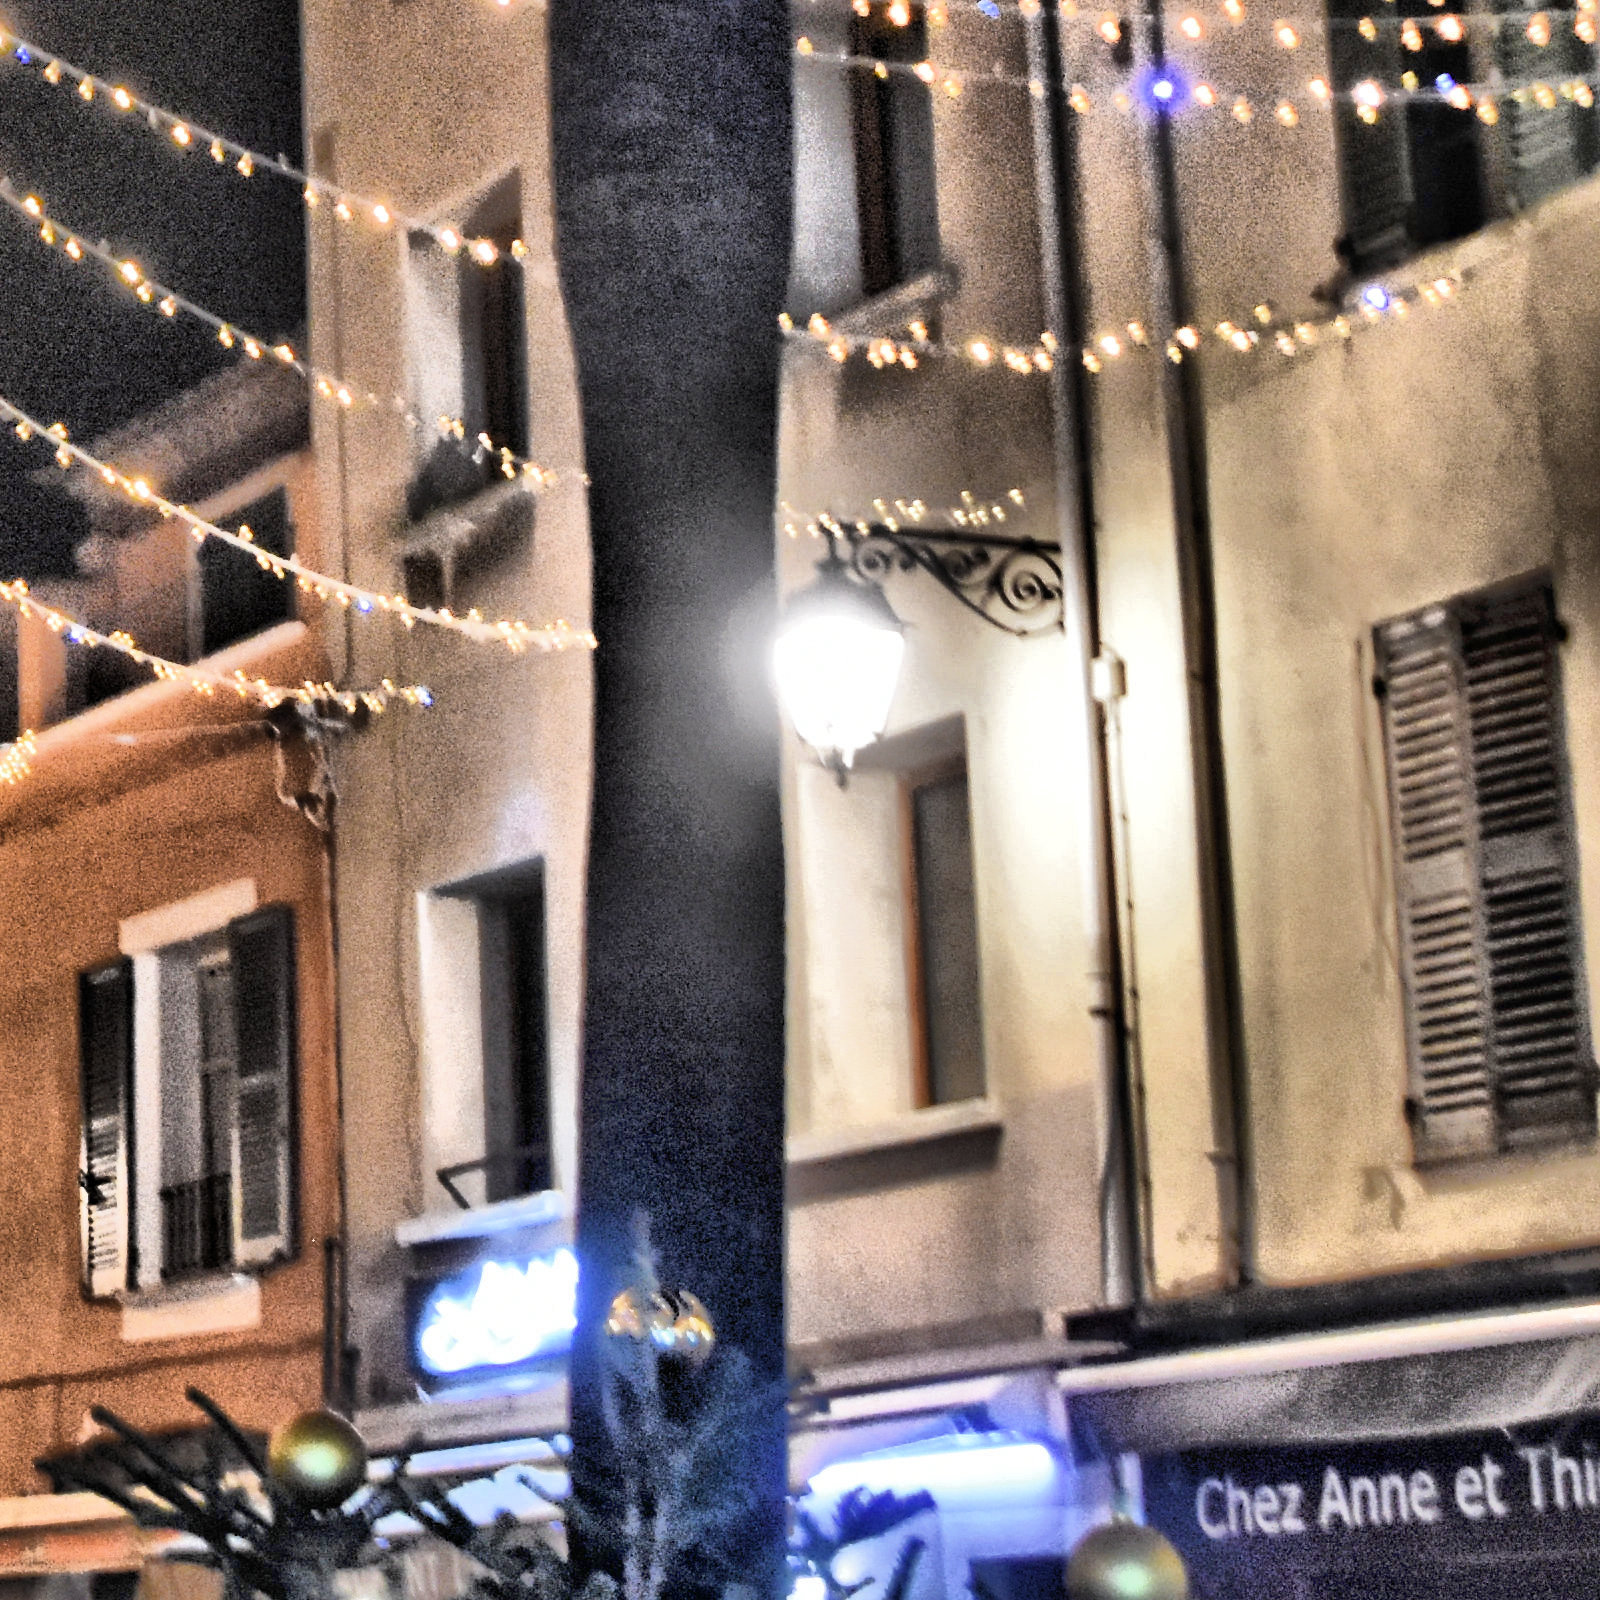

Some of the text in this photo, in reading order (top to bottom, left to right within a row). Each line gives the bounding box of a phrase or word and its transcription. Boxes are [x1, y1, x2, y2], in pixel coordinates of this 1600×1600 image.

[1196, 1444, 1600, 1539] Chez Anne et Thi
